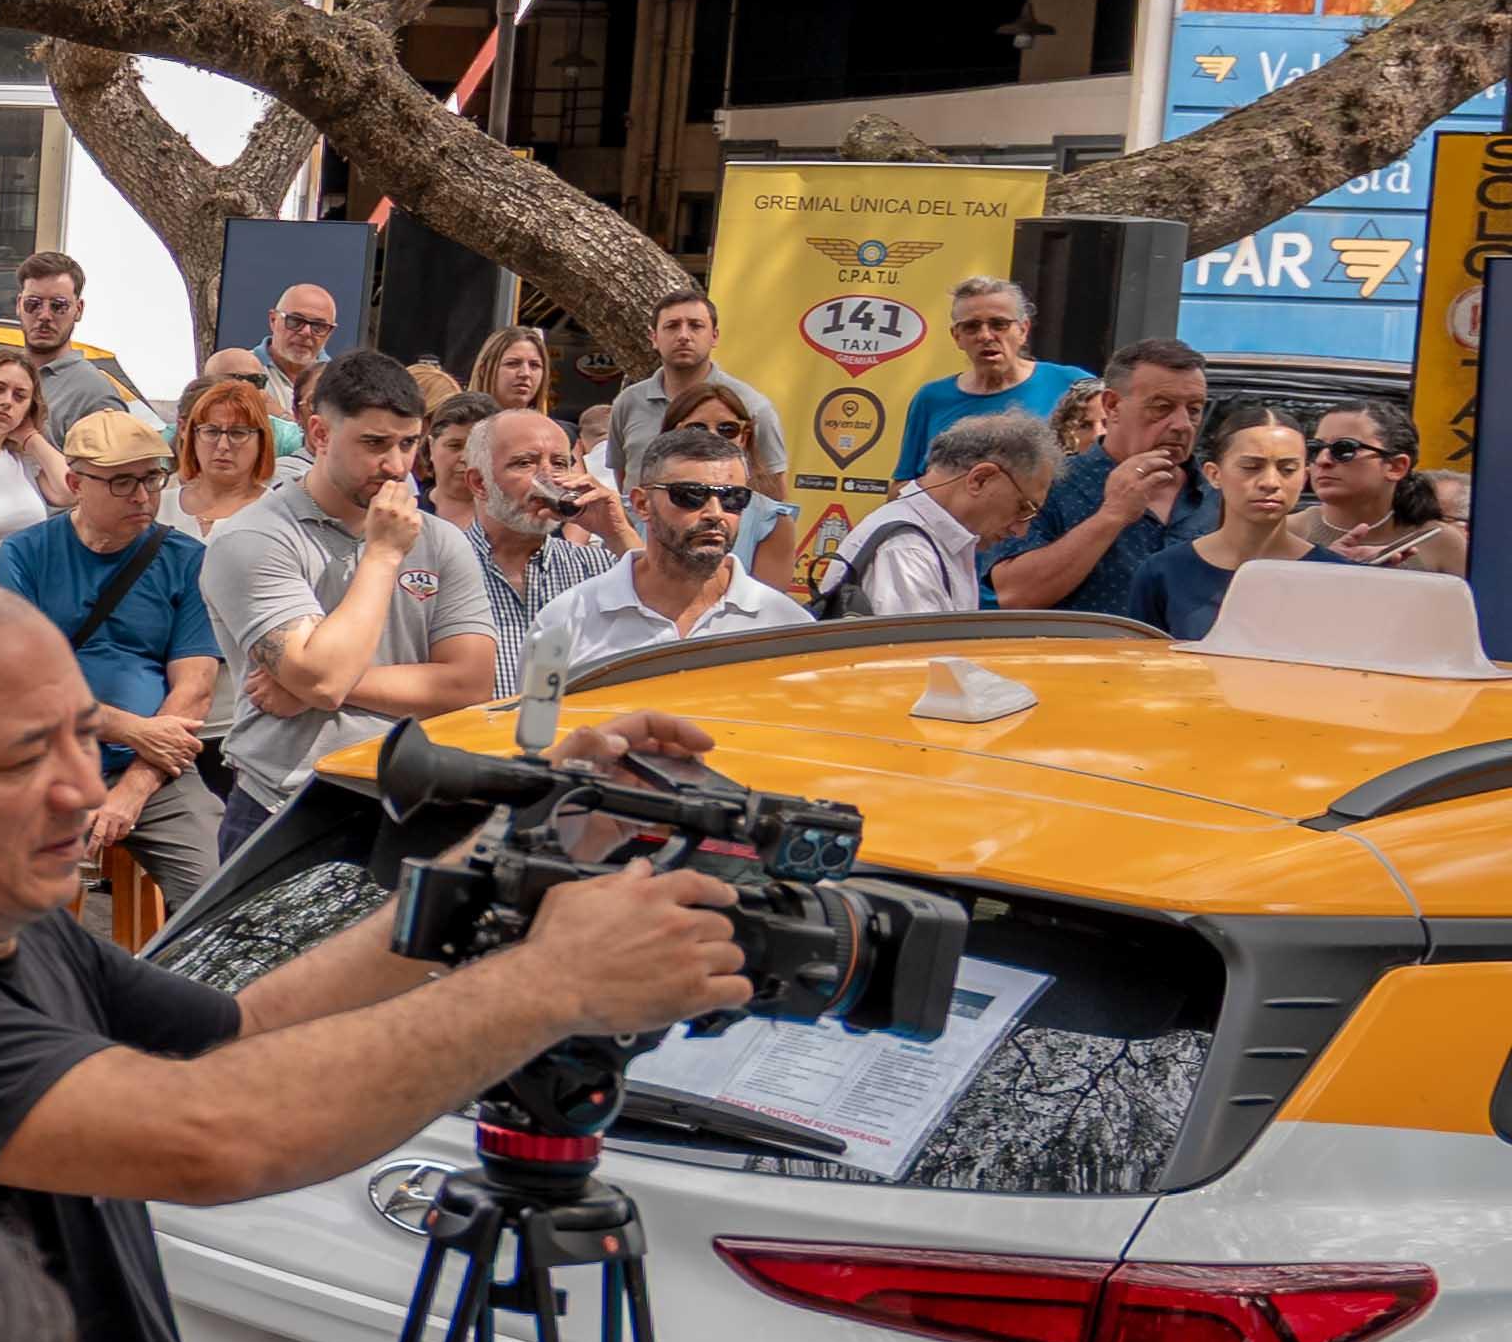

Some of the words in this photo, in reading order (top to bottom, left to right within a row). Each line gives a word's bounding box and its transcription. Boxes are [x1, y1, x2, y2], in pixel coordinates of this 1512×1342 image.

[754, 195, 843, 212] GREMIAL
[850, 195, 912, 214] ÚNICA
[917, 199, 957, 216] DEL
[964, 201, 1007, 218] TAXI
[838, 269, 900, 284] C.P.A.T.U.
[822, 301, 903, 338] 141
[841, 339, 879, 352] TAXI
